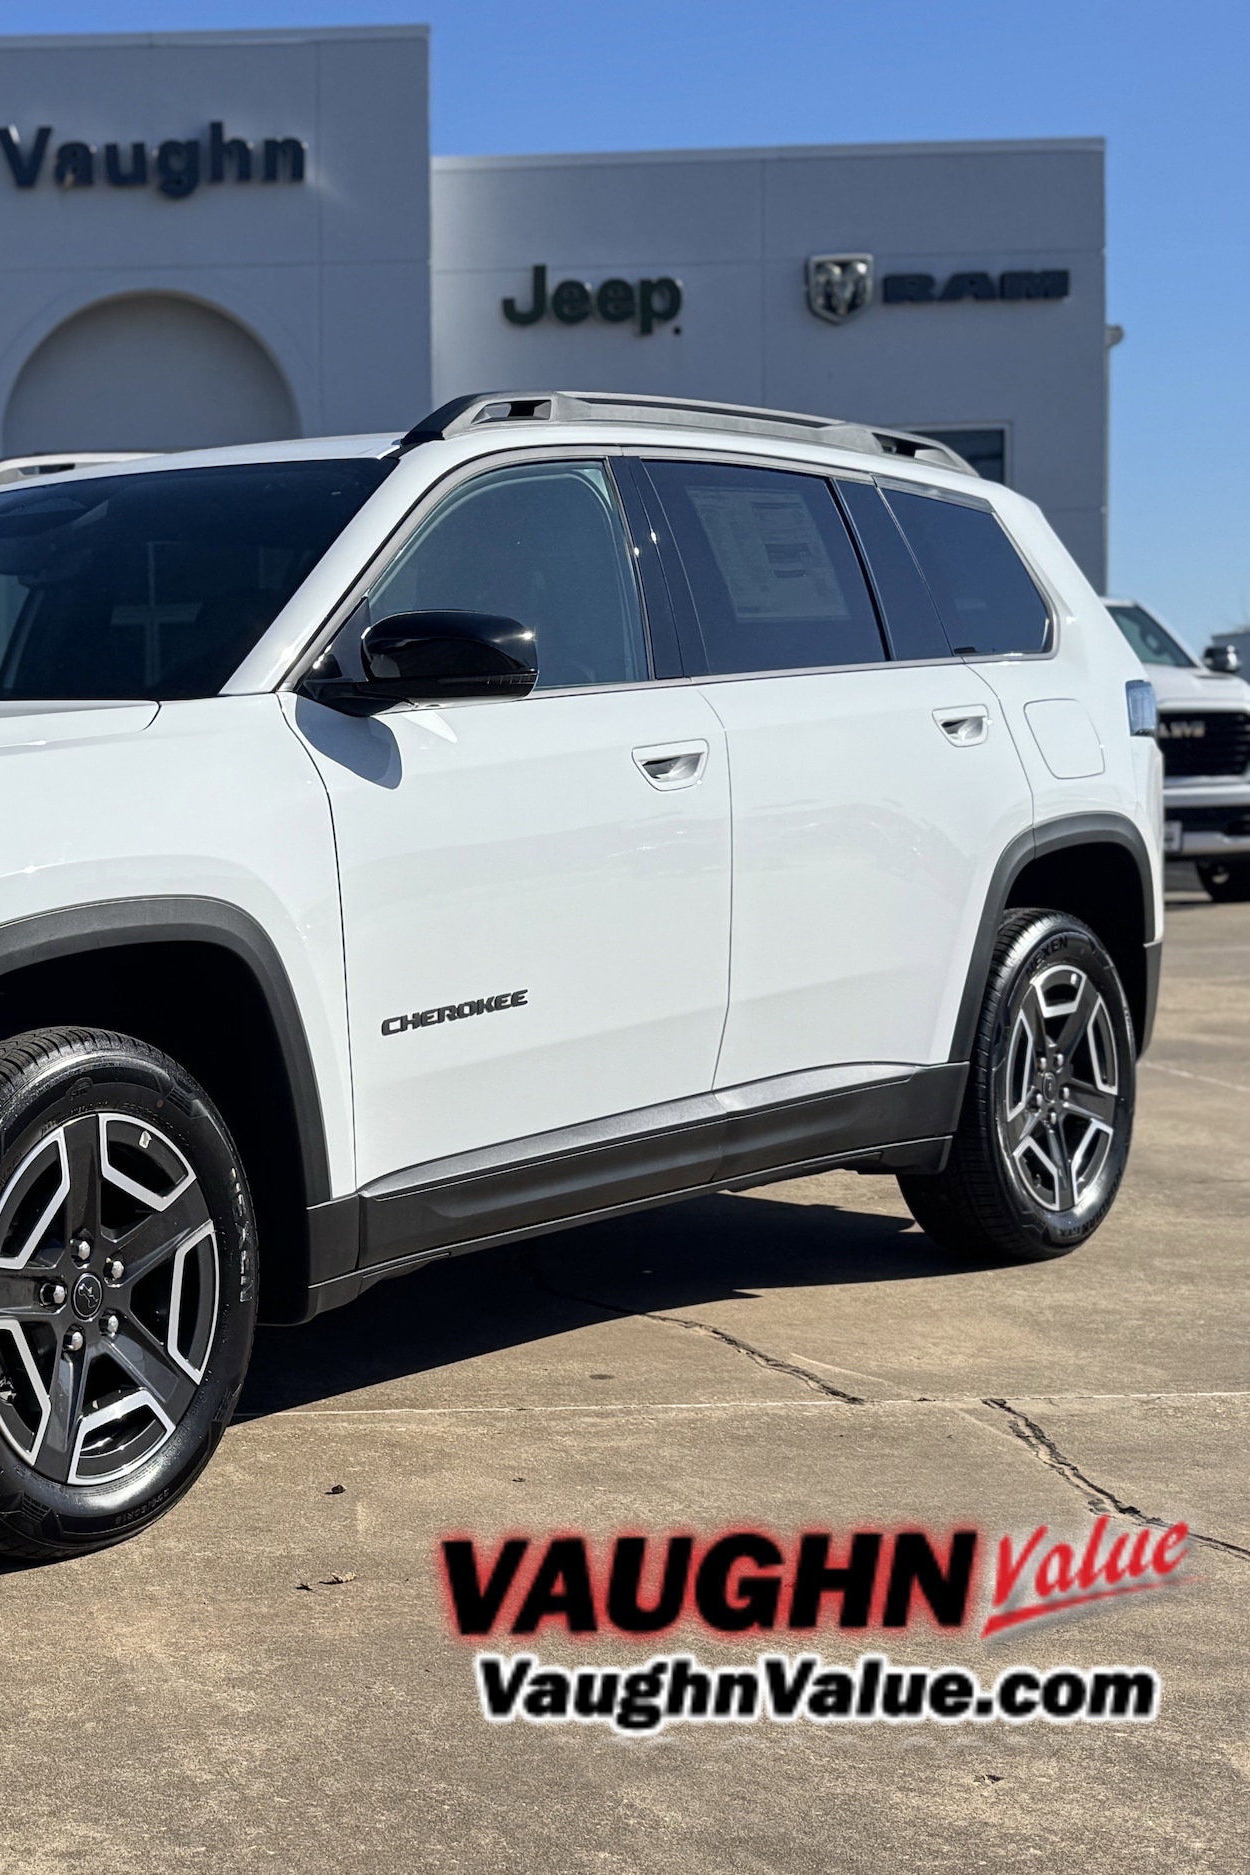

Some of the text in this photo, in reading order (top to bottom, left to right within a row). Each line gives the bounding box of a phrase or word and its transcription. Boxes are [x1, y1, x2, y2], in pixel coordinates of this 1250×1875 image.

[502, 264, 684, 335] Jeep
[882, 269, 1070, 305] RAM
[1154, 720, 1206, 738] AM
[381, 988, 528, 1037] CHEROKEE
